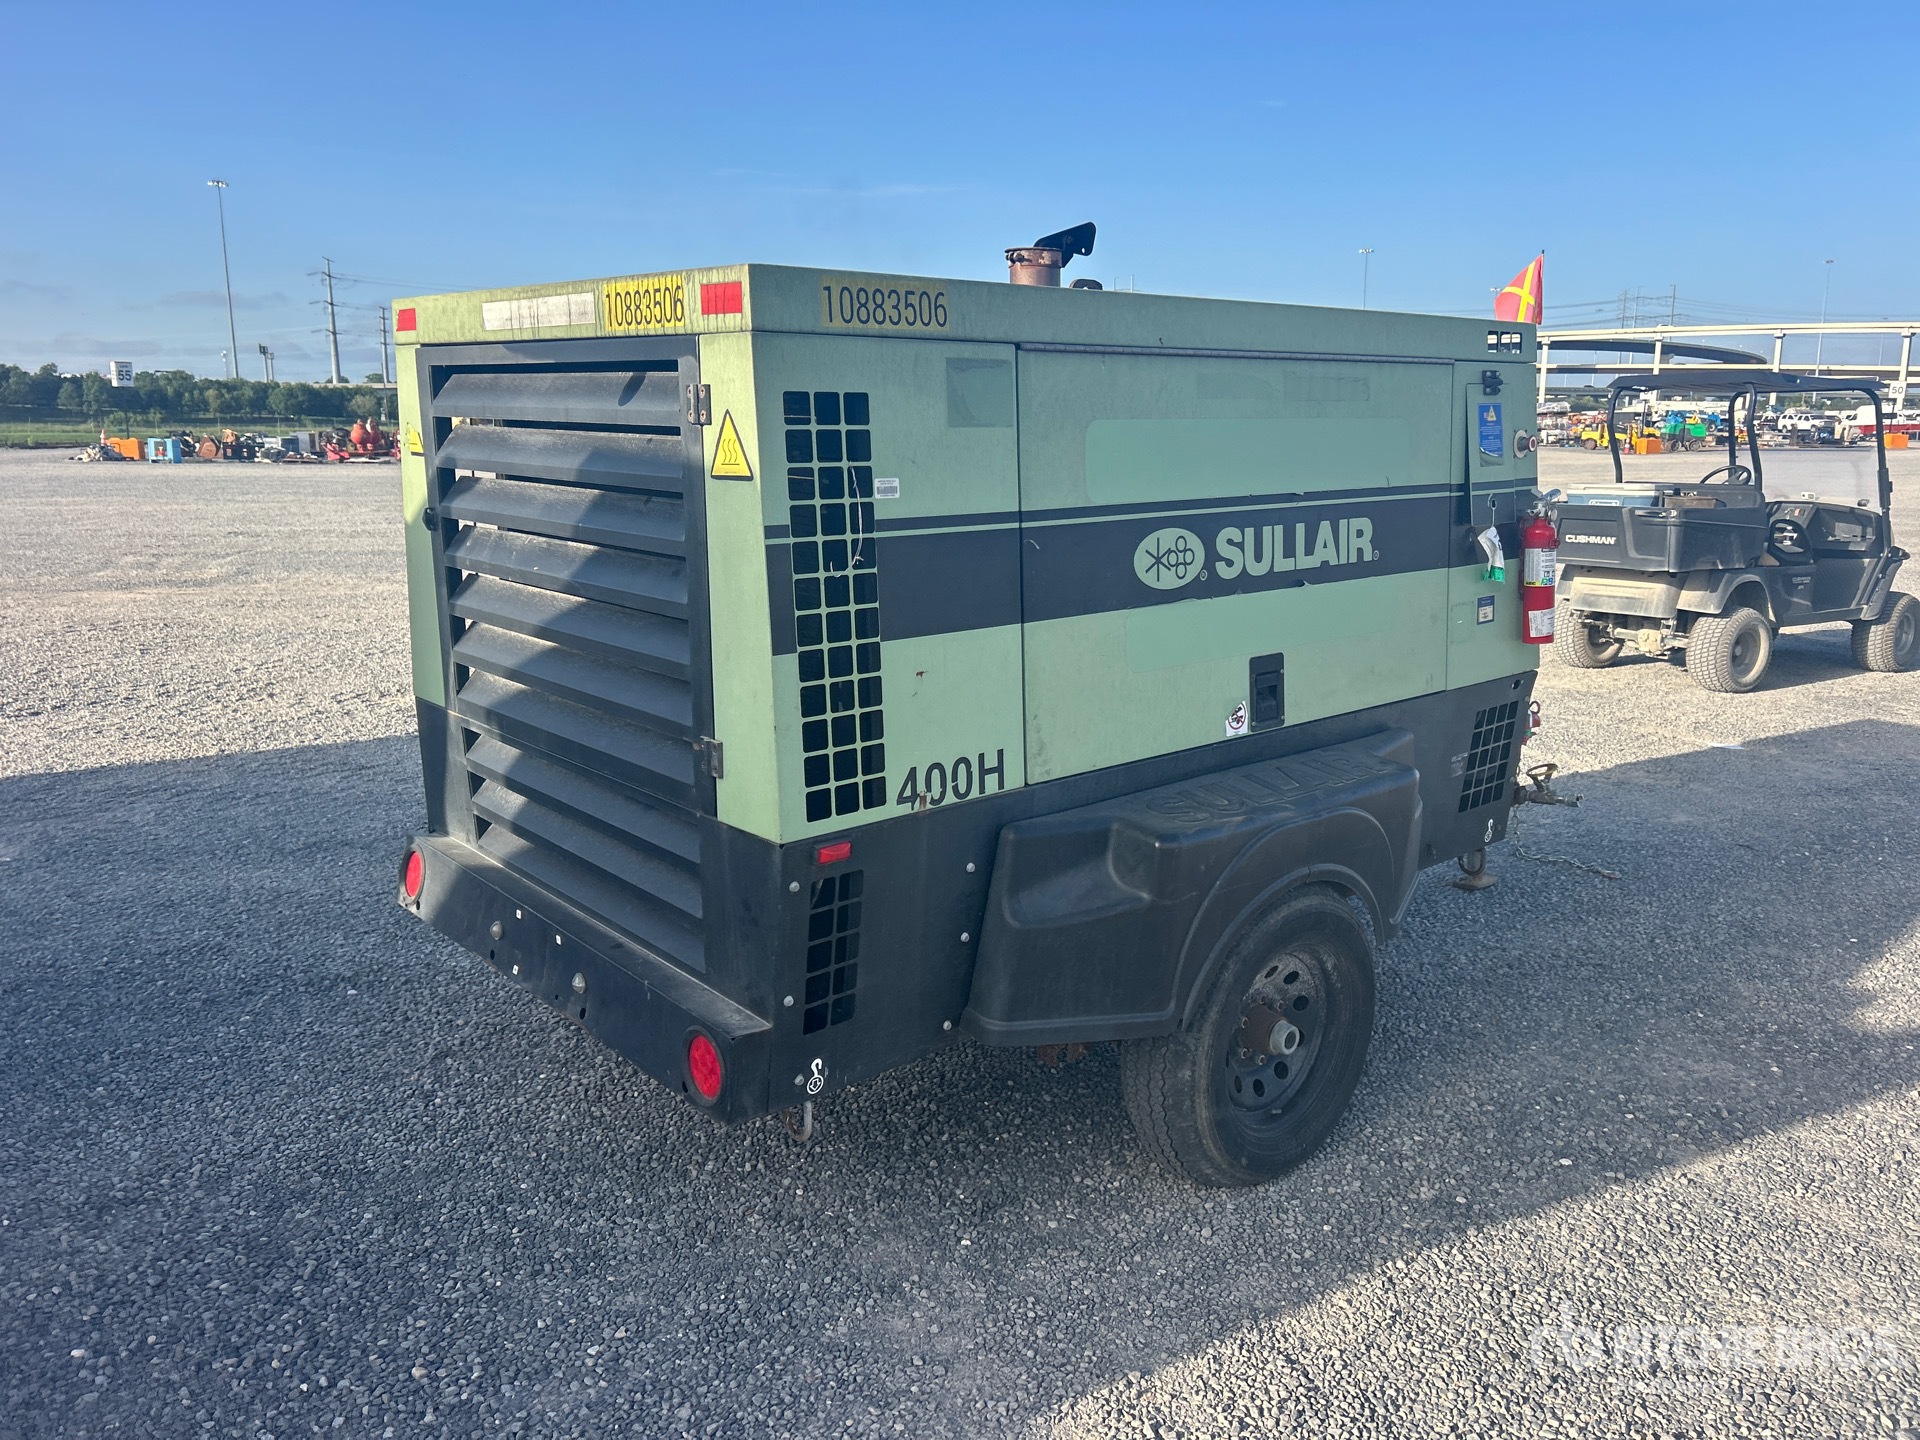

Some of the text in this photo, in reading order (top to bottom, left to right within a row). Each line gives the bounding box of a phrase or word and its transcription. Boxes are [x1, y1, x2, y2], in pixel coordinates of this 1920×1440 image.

[604, 284, 684, 328] 10883506
[822, 285, 948, 328] 10883506
[118, 369, 131, 381] 55
[1891, 386, 1904, 395] 50
[1215, 517, 1373, 580] SULLAIR
[1565, 534, 1616, 545] CUSHMAN
[896, 748, 1005, 812] 400H
